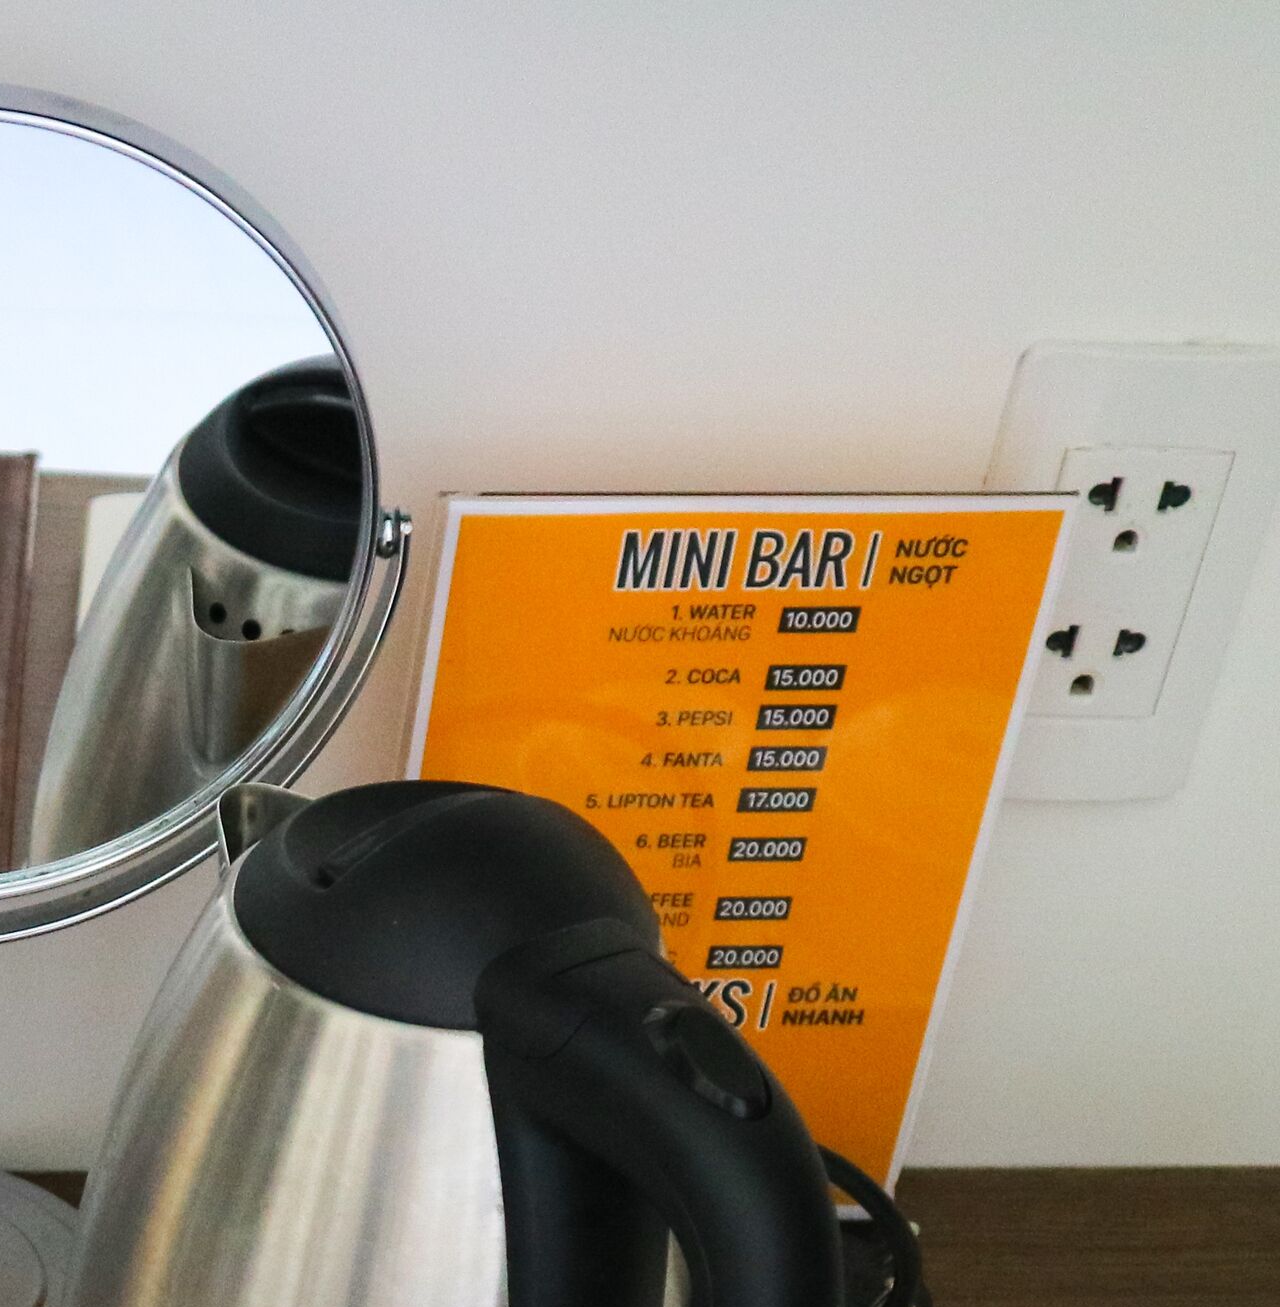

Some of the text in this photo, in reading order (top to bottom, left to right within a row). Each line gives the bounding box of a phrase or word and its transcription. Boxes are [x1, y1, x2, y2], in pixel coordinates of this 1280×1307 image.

[614, 528, 854, 592] MINI BAR
[888, 564, 959, 588] NGỌT
[689, 603, 854, 631] WATER 10.000
[686, 669, 840, 688] COCA 15.000
[676, 708, 831, 728] PEPSI 15.000
[662, 749, 821, 769] FANTA 15.000
[606, 791, 810, 810] LIPTON TEA 17.000
[656, 833, 803, 859] BEER 20.000
[719, 899, 789, 919] 20.000
[711, 948, 780, 967] 20.000
[781, 1009, 865, 1027] NHANH
